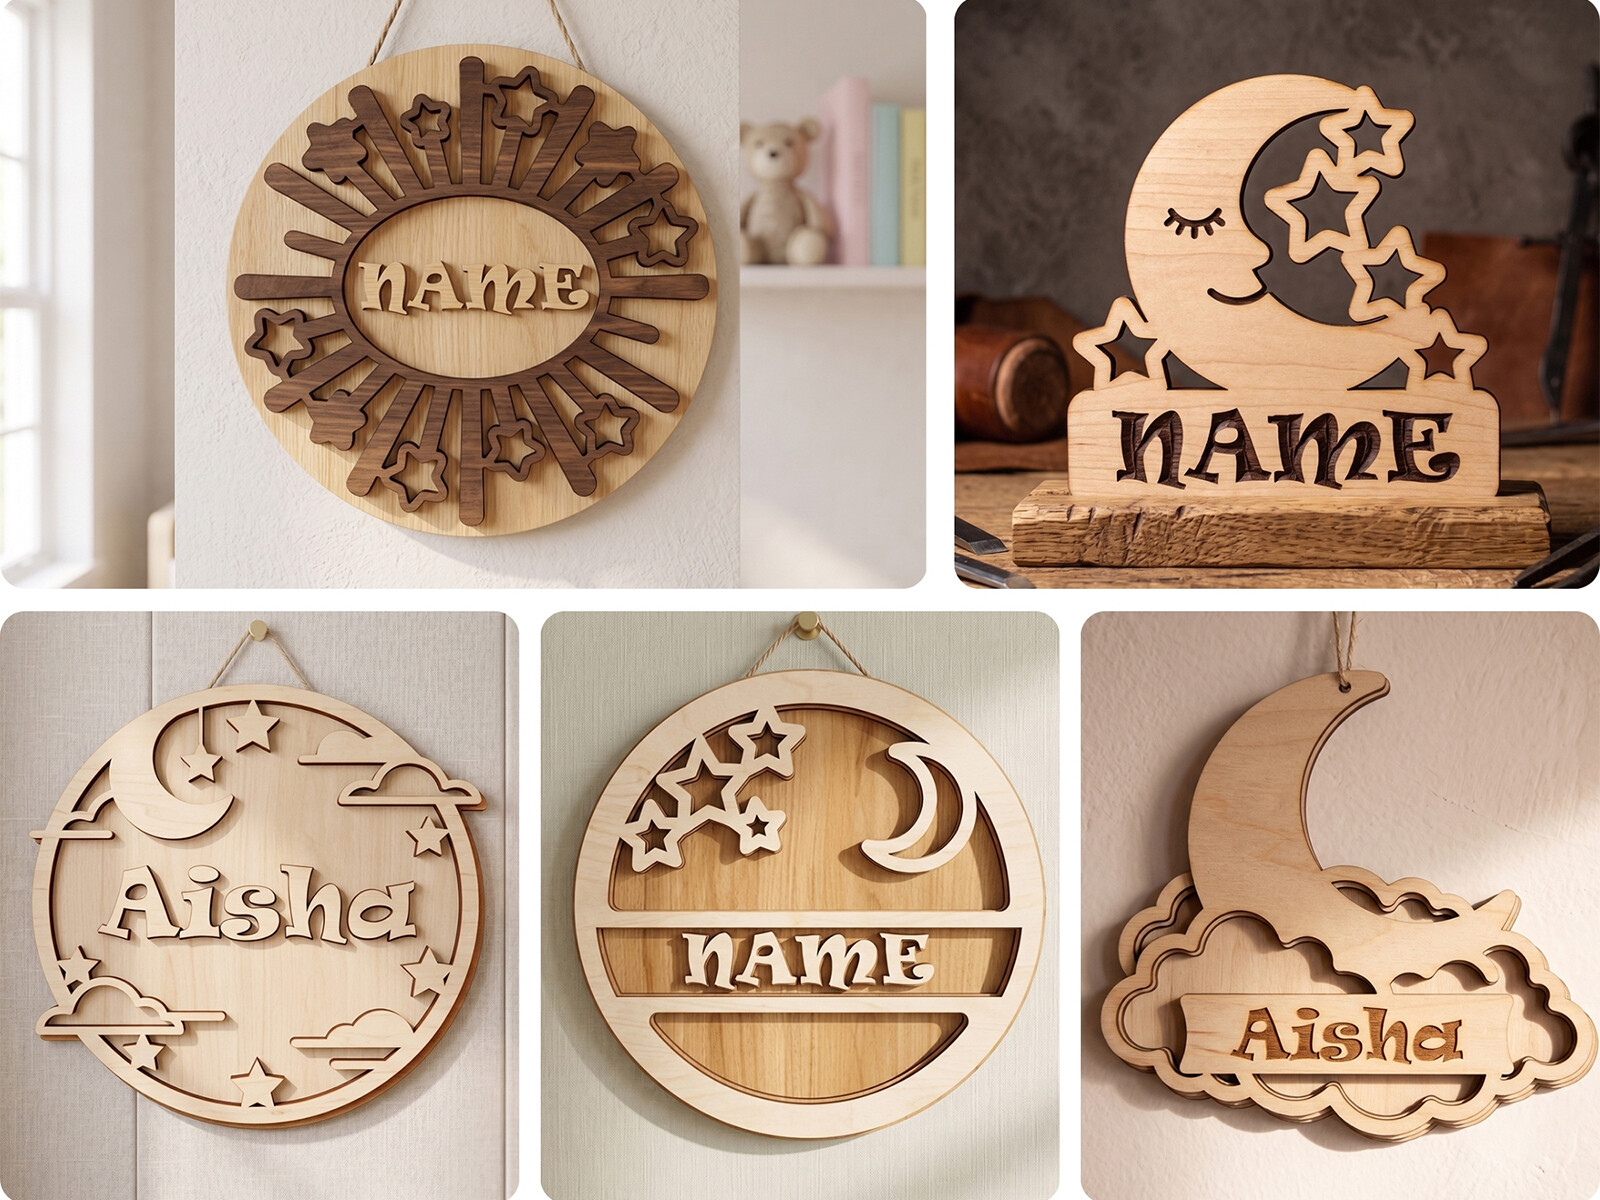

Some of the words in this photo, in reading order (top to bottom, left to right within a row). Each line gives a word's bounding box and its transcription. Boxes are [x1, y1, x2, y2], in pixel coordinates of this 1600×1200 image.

[358, 260, 590, 316] NAME
[1111, 407, 1461, 490] NAME
[97, 864, 417, 945] Aisha
[681, 931, 935, 991] NAME
[1230, 1006, 1464, 1065] Aisha
